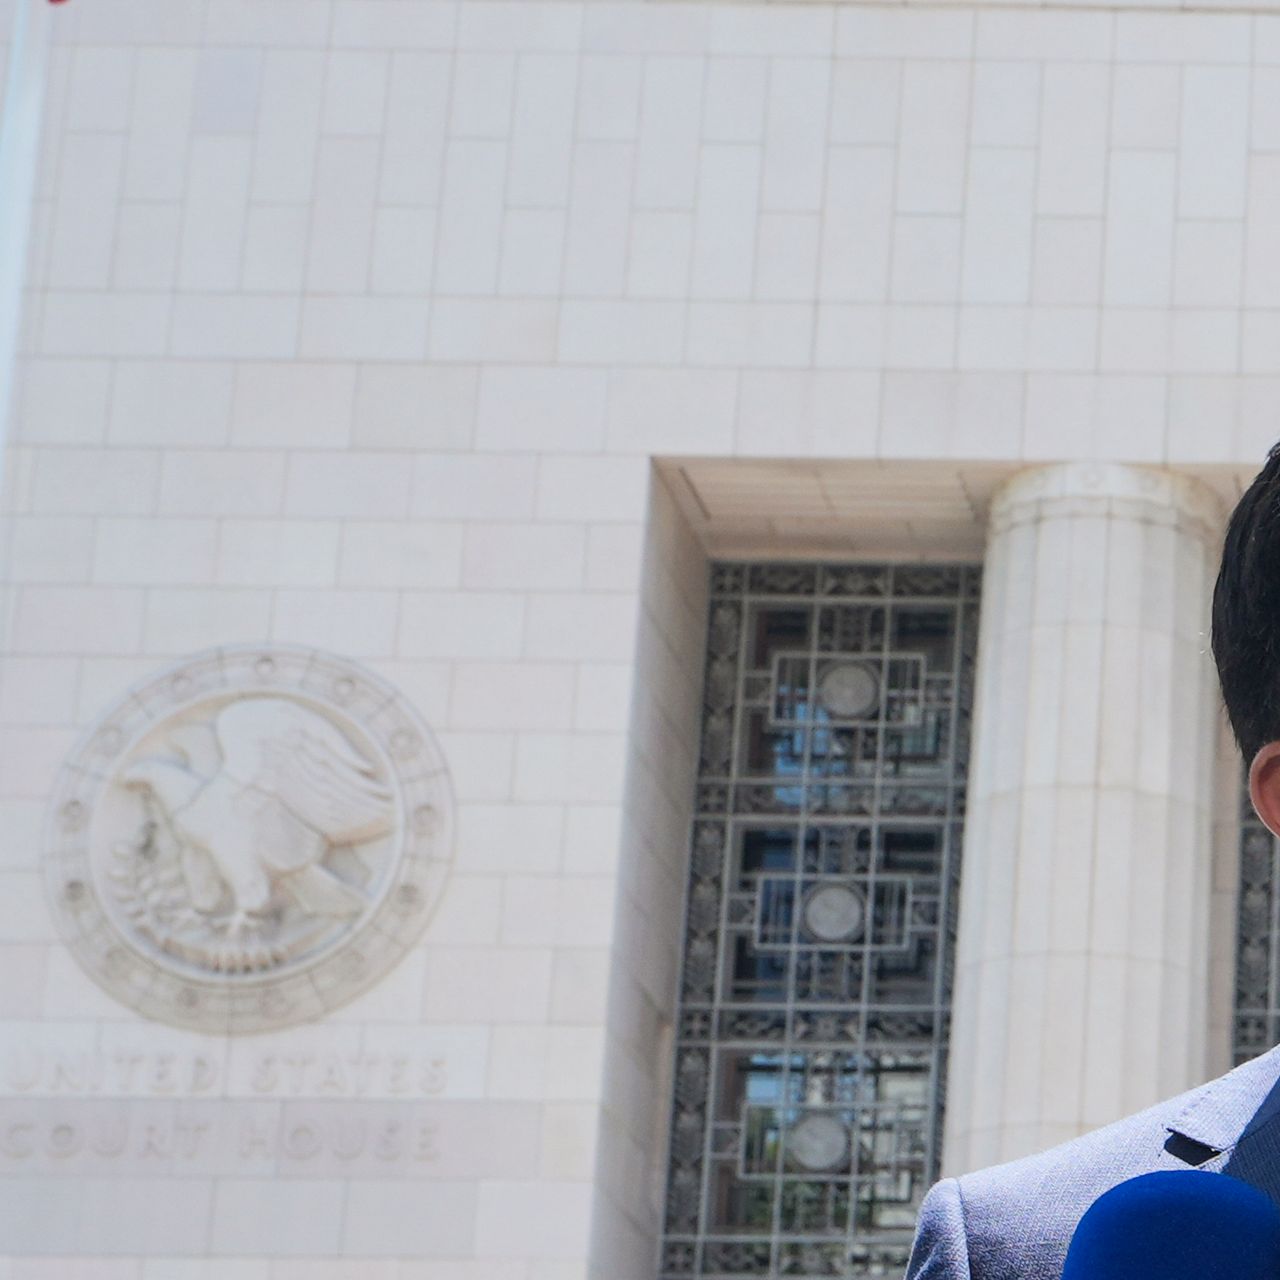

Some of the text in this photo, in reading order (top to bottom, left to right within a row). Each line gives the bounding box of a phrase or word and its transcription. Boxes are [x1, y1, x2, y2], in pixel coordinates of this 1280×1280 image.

[7, 1053, 449, 1094] UNITED STATES
[0, 1119, 443, 1164] COURT HOUSE
